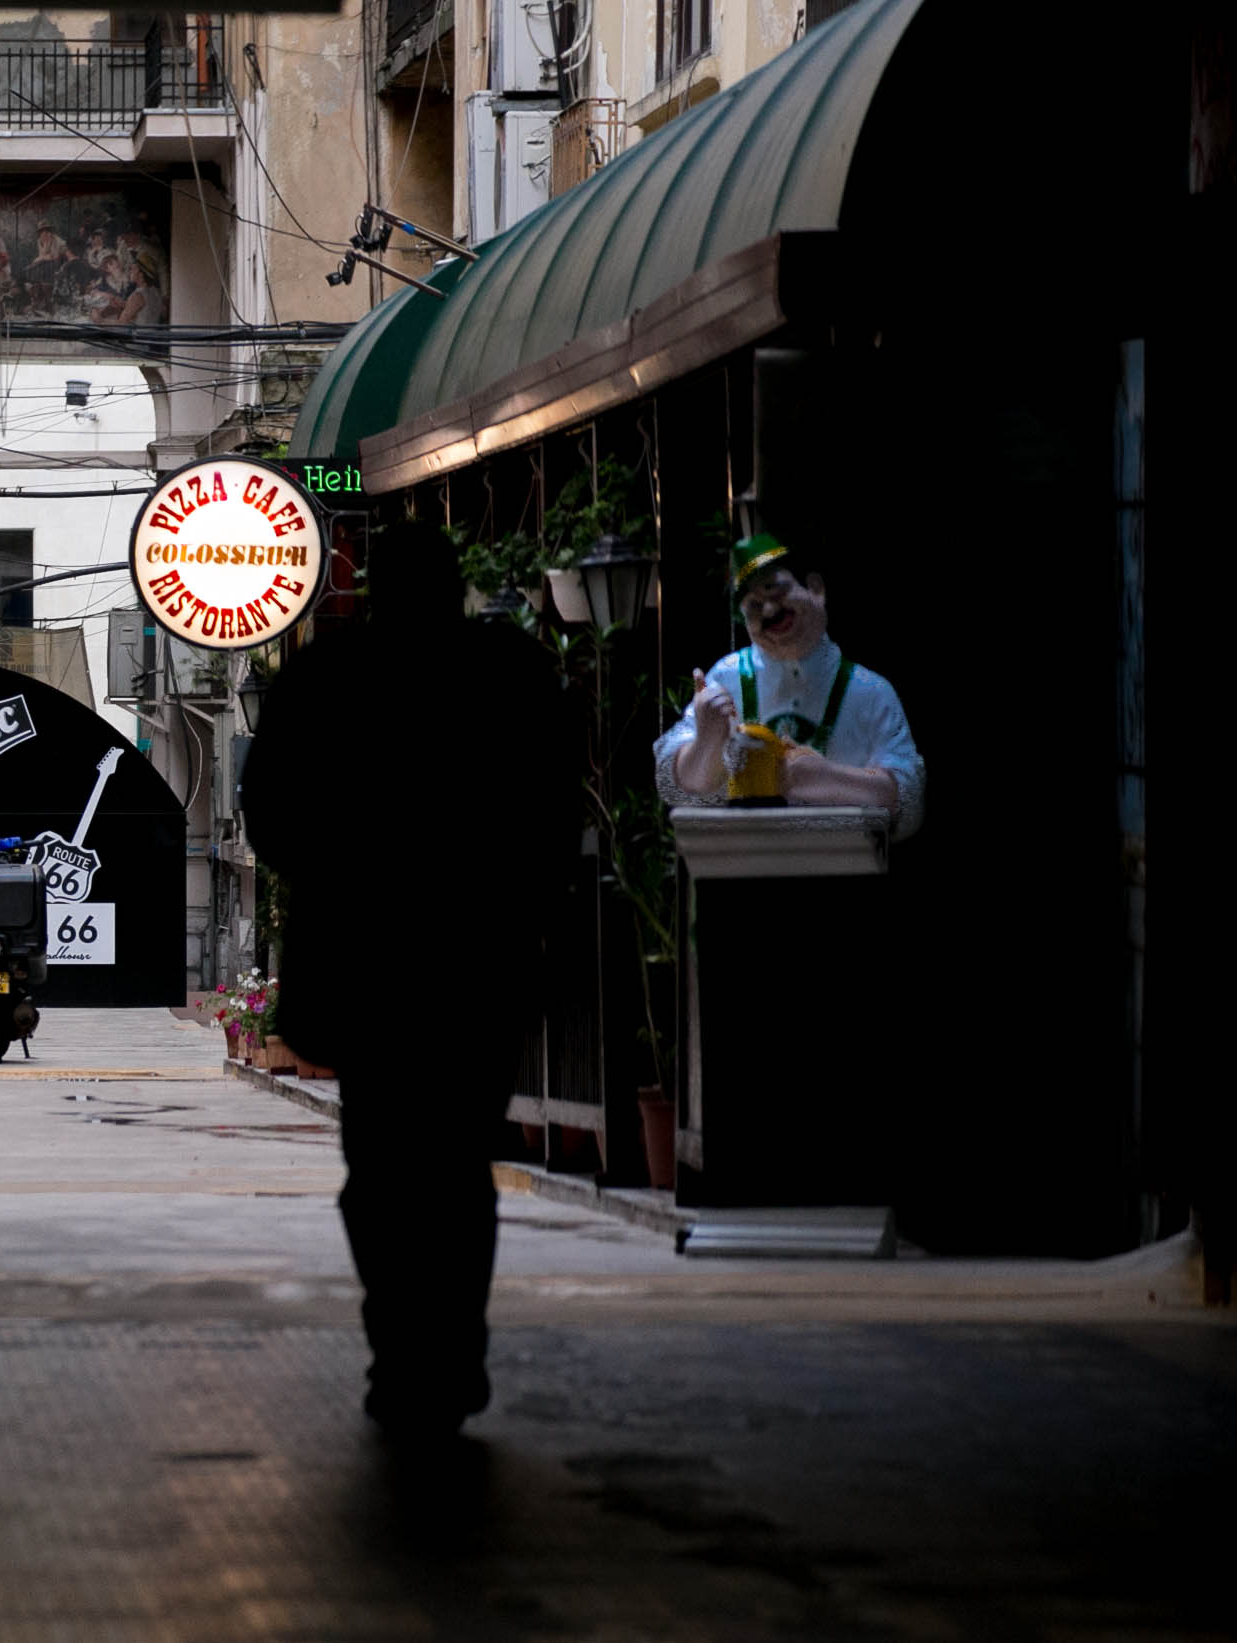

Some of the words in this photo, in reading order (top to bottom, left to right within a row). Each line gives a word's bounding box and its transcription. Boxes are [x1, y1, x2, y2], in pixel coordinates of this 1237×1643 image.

[149, 472, 228, 534] PIZZA
[242, 475, 306, 537] CAFE
[146, 543, 308, 567] COLOSSEUM
[148, 569, 305, 639] RISTORANTE
[52, 846, 92, 870] ROUTE
[45, 862, 81, 896] 66
[57, 914, 98, 944] 66
